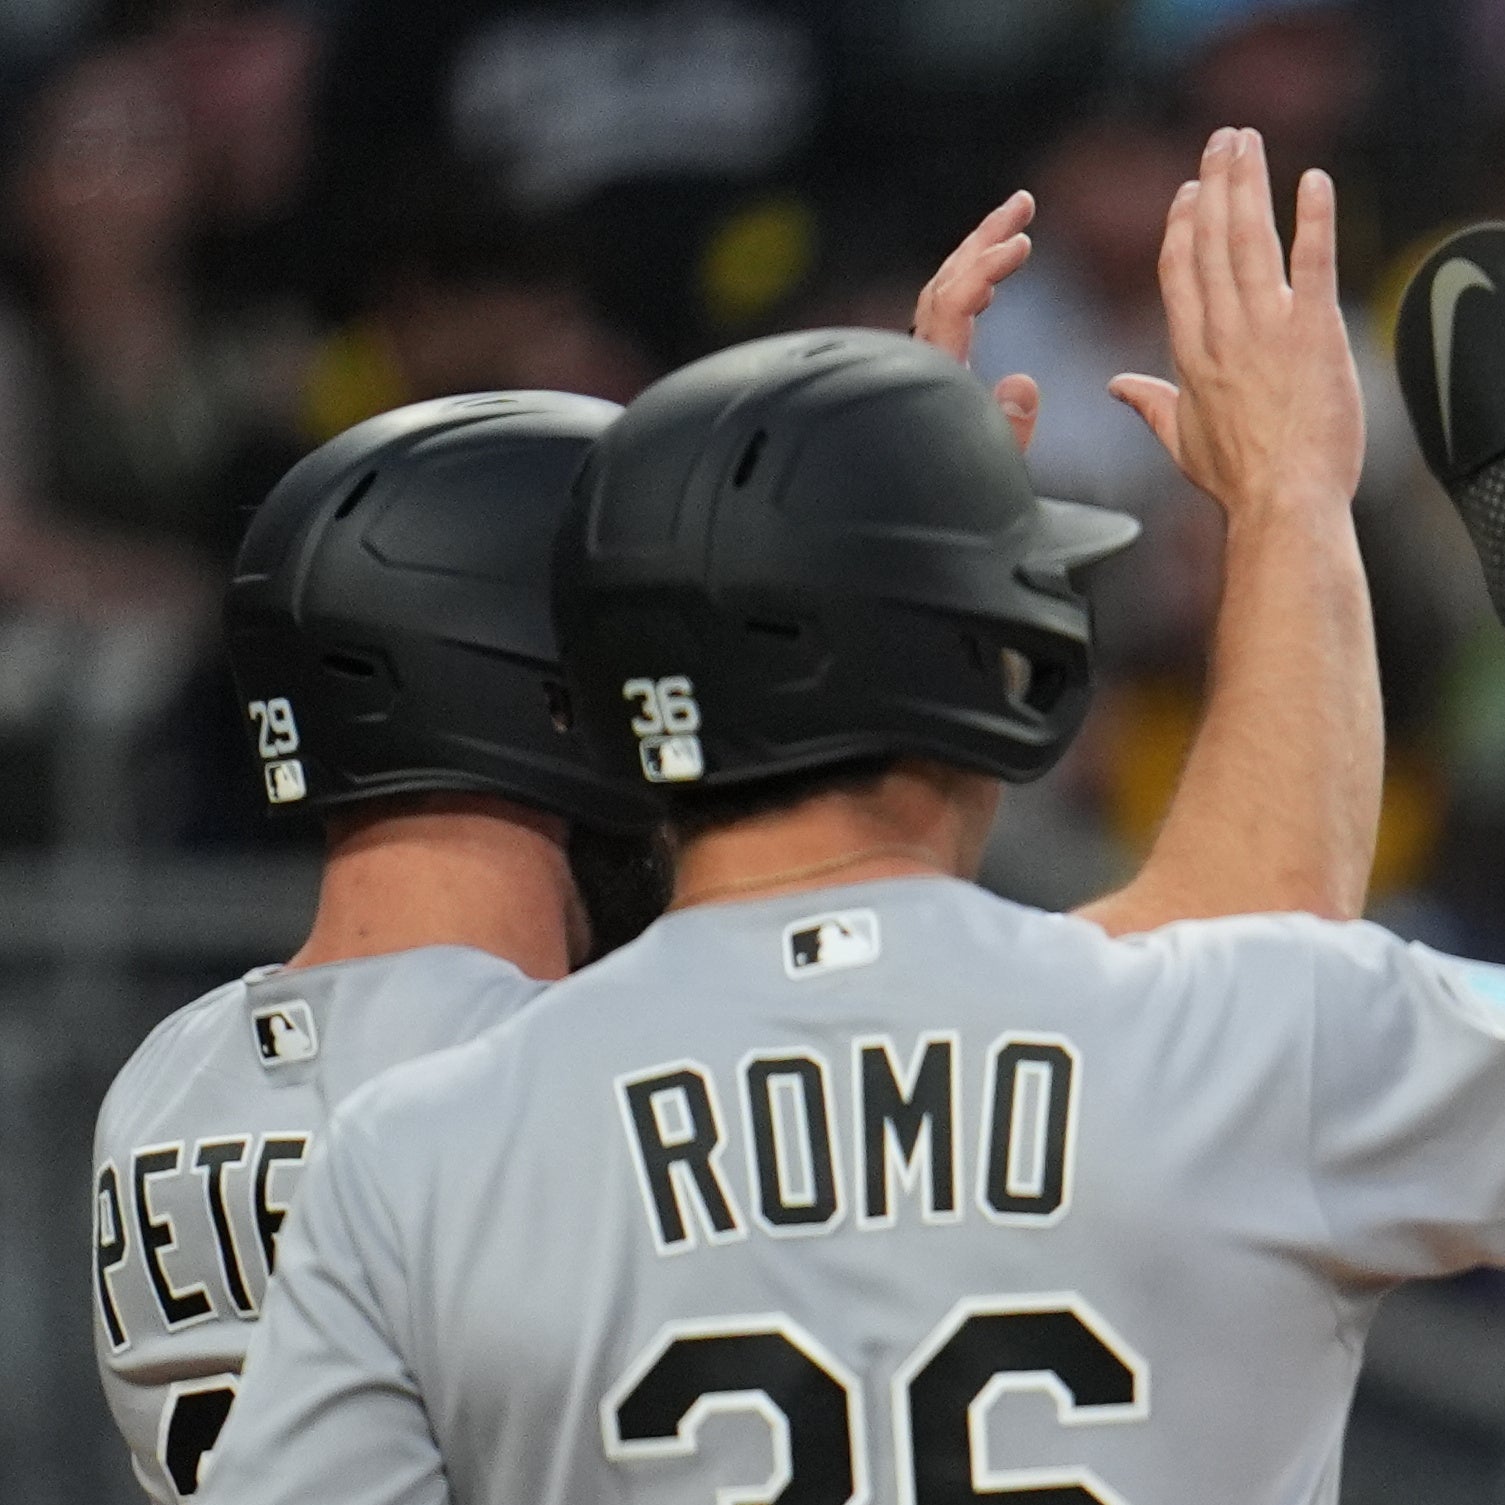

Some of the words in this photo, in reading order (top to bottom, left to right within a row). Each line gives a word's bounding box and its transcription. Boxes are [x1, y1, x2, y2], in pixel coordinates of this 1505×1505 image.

[248, 697, 300, 759] 29
[622, 676, 702, 737] 36
[614, 1030, 1083, 1256] ROMO
